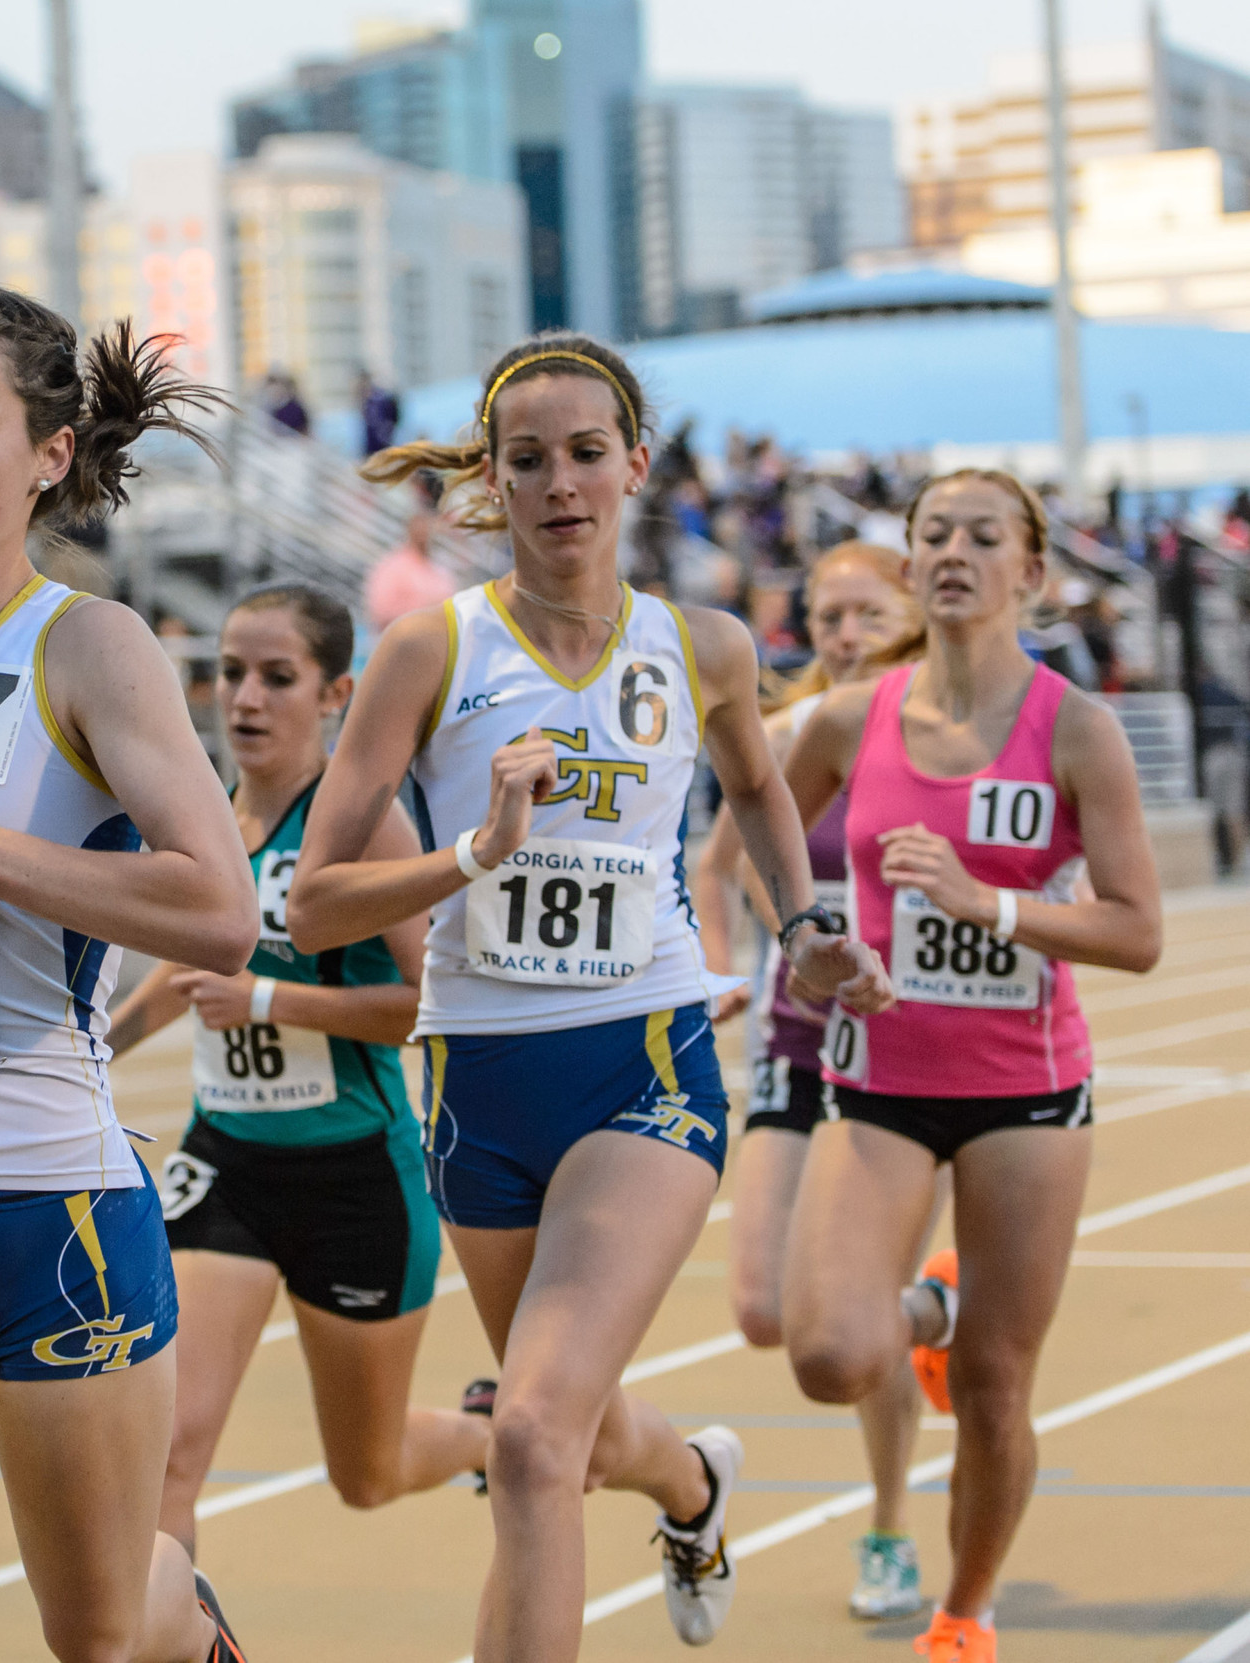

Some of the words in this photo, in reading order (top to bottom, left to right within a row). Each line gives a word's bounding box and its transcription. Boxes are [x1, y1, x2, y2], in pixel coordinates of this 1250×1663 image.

[456, 692, 500, 715] ACC
[618, 660, 669, 747] 6
[979, 786, 1043, 842] 10
[501, 851, 584, 872] ORGIA
[593, 856, 645, 876] TECH
[499, 874, 617, 952] 181
[480, 951, 547, 972] TRACK
[555, 958, 569, 974] &
[578, 959, 636, 978] FIELD
[915, 917, 1017, 977] 388
[222, 1022, 285, 1080] 86
[271, 1081, 322, 1100] FIELD
